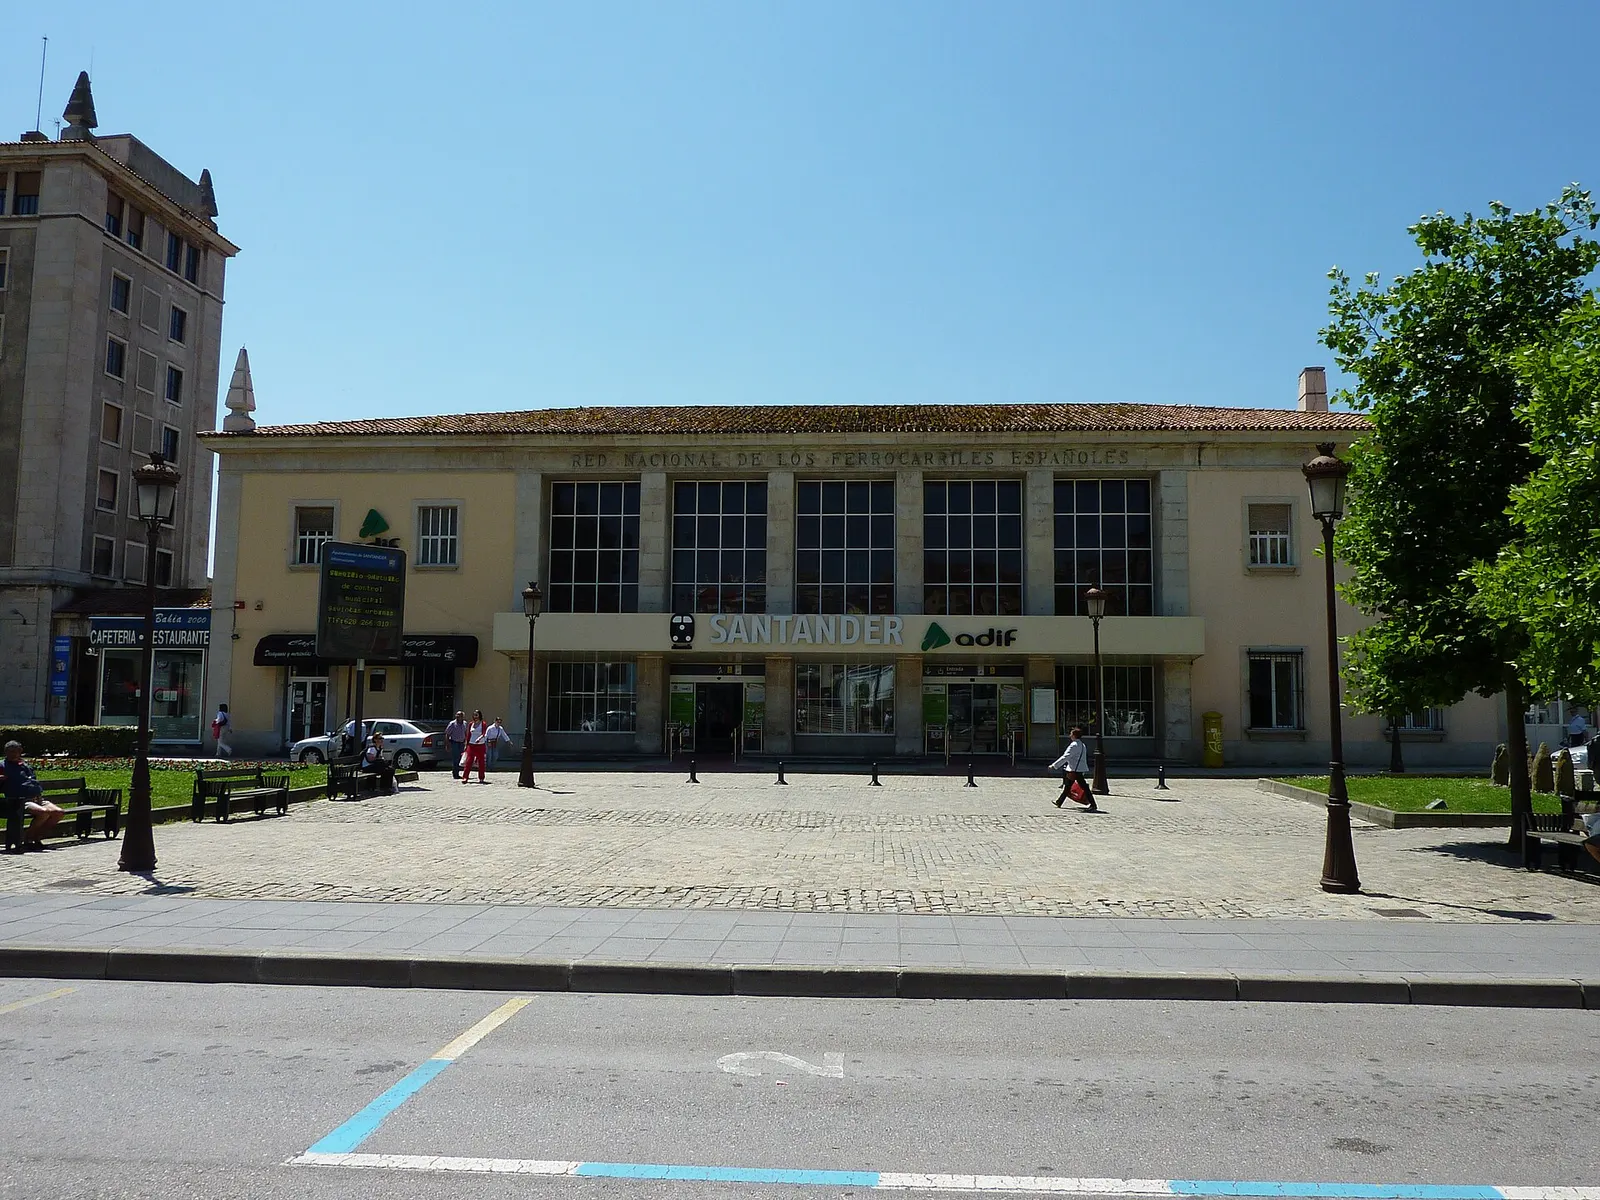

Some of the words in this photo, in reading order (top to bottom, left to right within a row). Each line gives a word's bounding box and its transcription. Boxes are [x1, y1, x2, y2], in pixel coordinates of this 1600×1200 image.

[572, 454, 608, 468] RED
[623, 453, 722, 467] NACIONAL
[738, 452, 762, 466] DE
[777, 452, 816, 466] LOS
[831, 451, 995, 466] FERROCARRILES
[1011, 448, 1129, 465] ESPAÑOLES
[187, 616, 207, 624] 2000
[708, 614, 904, 645] SANTANDER
[90, 629, 136, 645] CAFETERIA
[954, 628, 1018, 647] adif
[716, 1051, 844, 1078] 2
